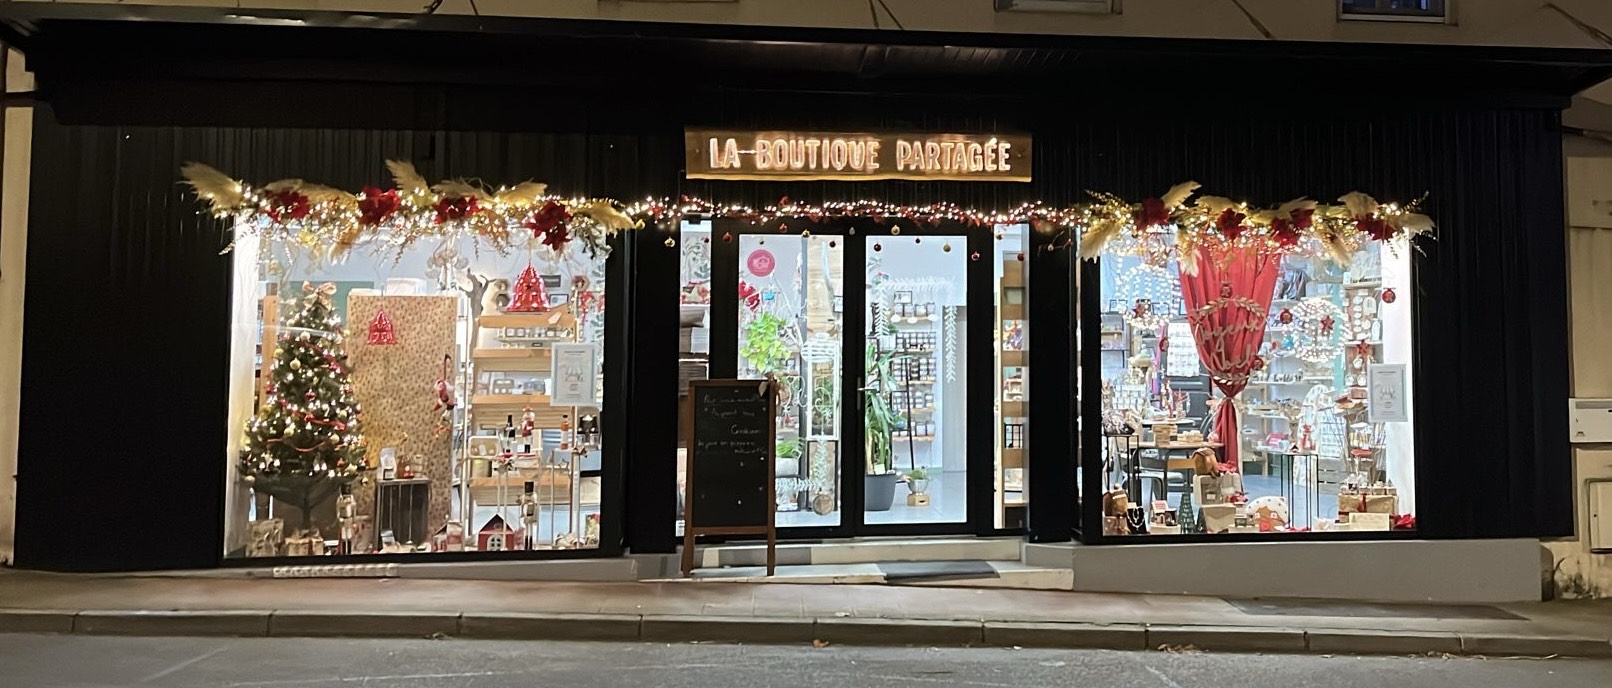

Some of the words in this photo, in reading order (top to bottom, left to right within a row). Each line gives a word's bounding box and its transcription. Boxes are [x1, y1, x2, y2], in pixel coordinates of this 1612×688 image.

[709, 138, 741, 169] LA
[755, 139, 880, 171] BOUTIQUE
[896, 137, 1012, 171] PARTAGÉE
